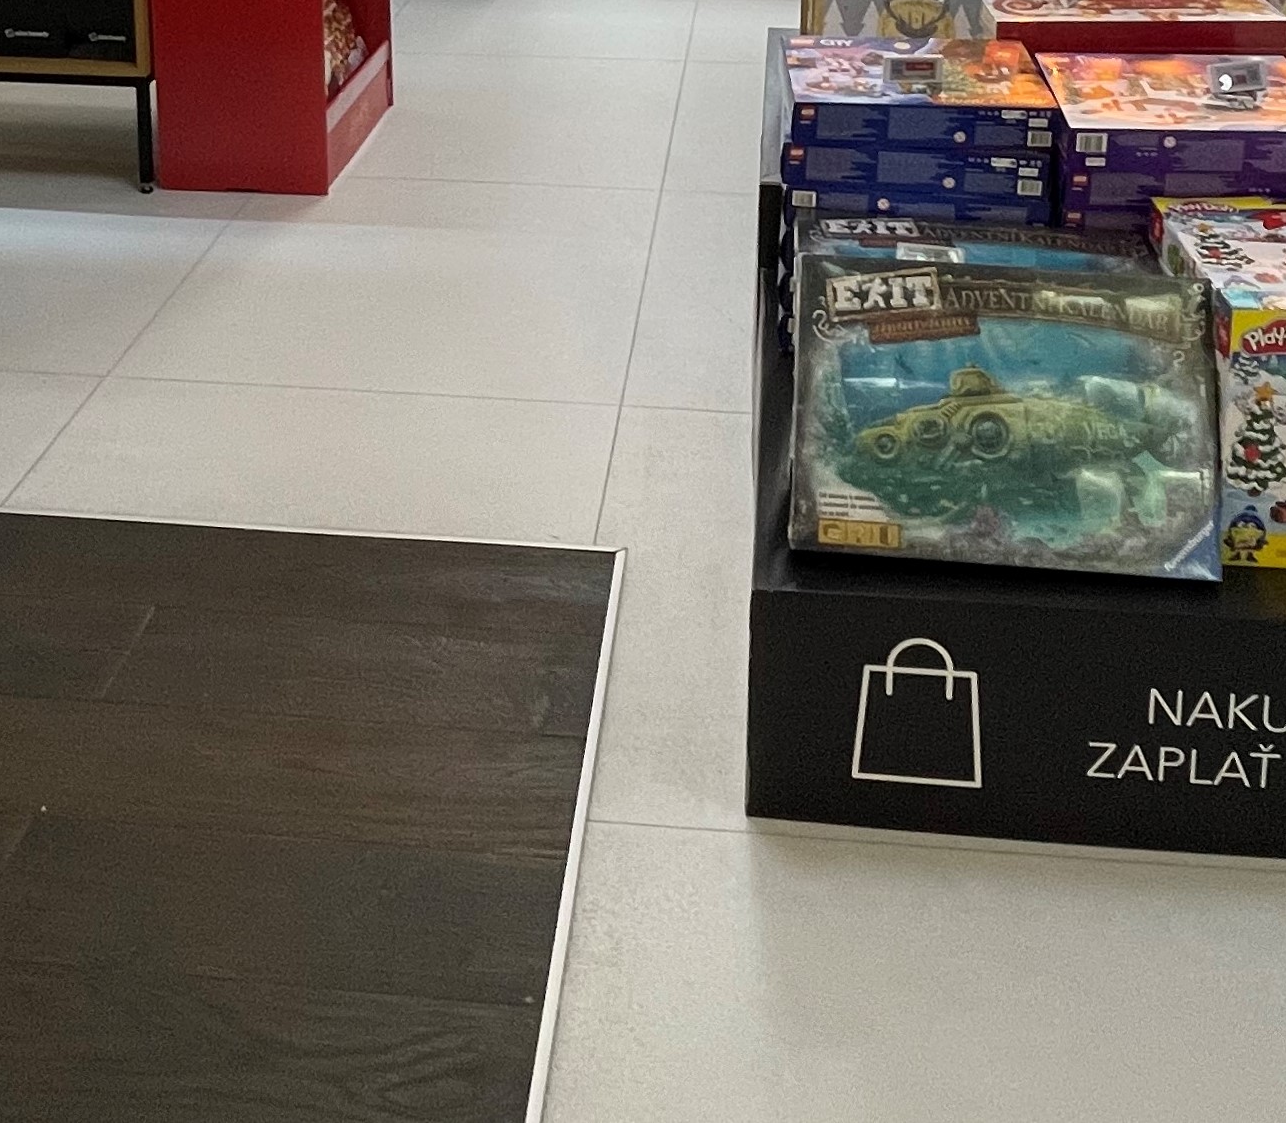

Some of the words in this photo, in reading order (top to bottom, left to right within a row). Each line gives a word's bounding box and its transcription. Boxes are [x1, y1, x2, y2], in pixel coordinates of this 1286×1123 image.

[819, 39, 853, 47] CITY
[823, 219, 916, 235] EXIT
[835, 274, 934, 311] EXIT
[1086, 741, 1282, 789] ZAPLAŤ
